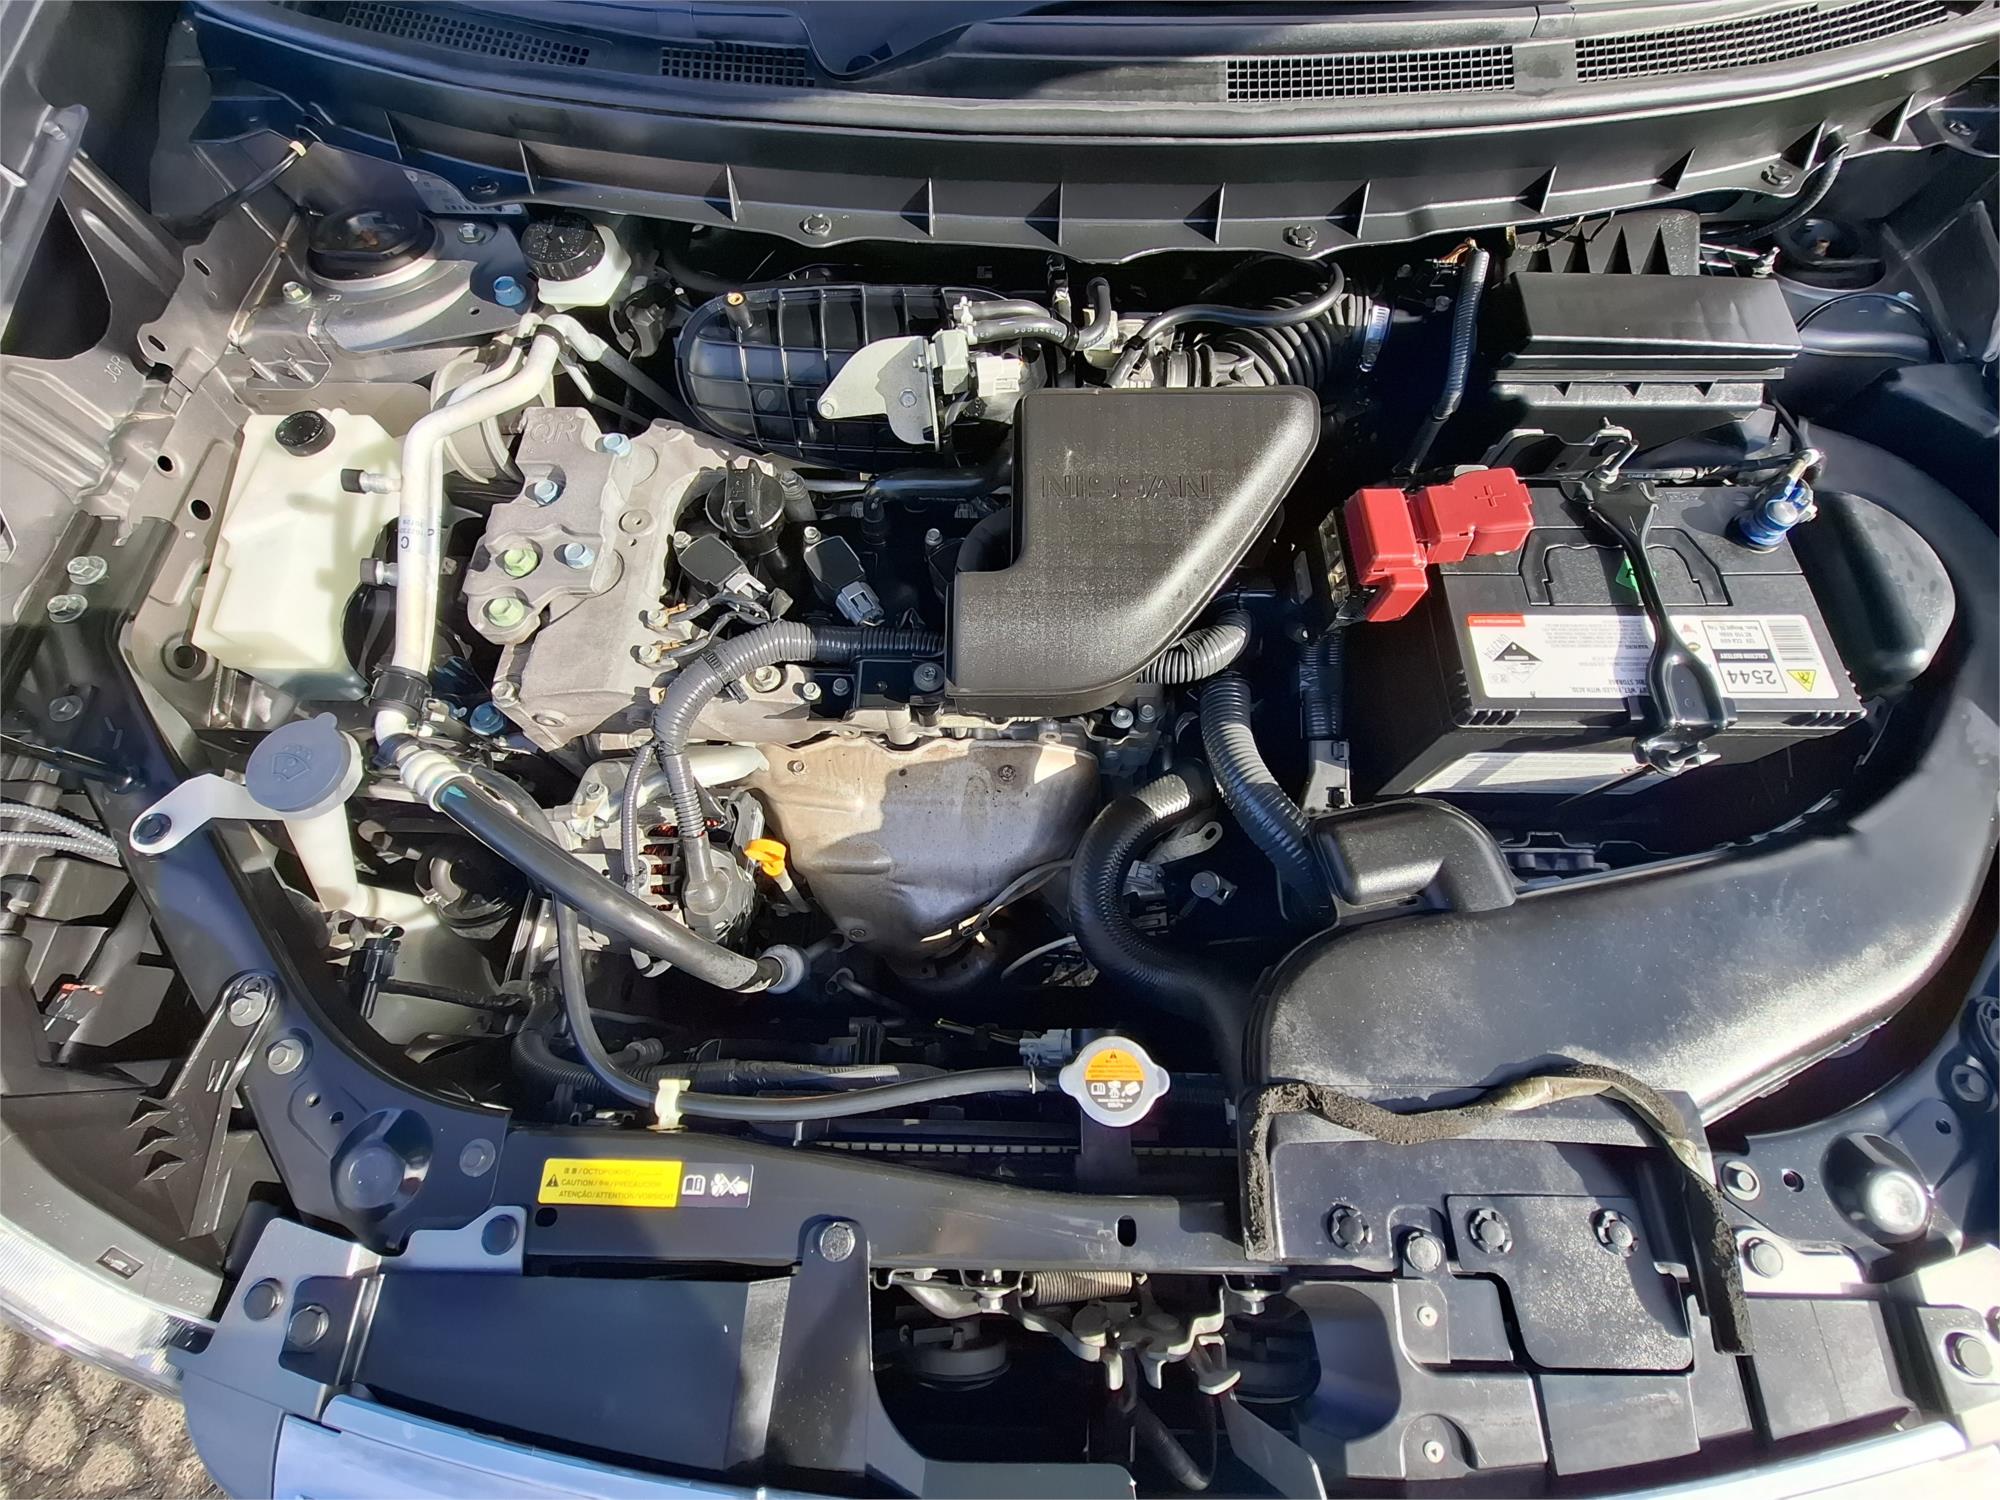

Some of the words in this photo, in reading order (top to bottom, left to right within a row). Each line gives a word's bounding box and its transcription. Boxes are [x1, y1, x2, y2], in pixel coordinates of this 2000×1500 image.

[104, 354, 127, 384] JGR
[1041, 474, 1211, 499] NISSAN
[1727, 669, 1777, 685] 2544
